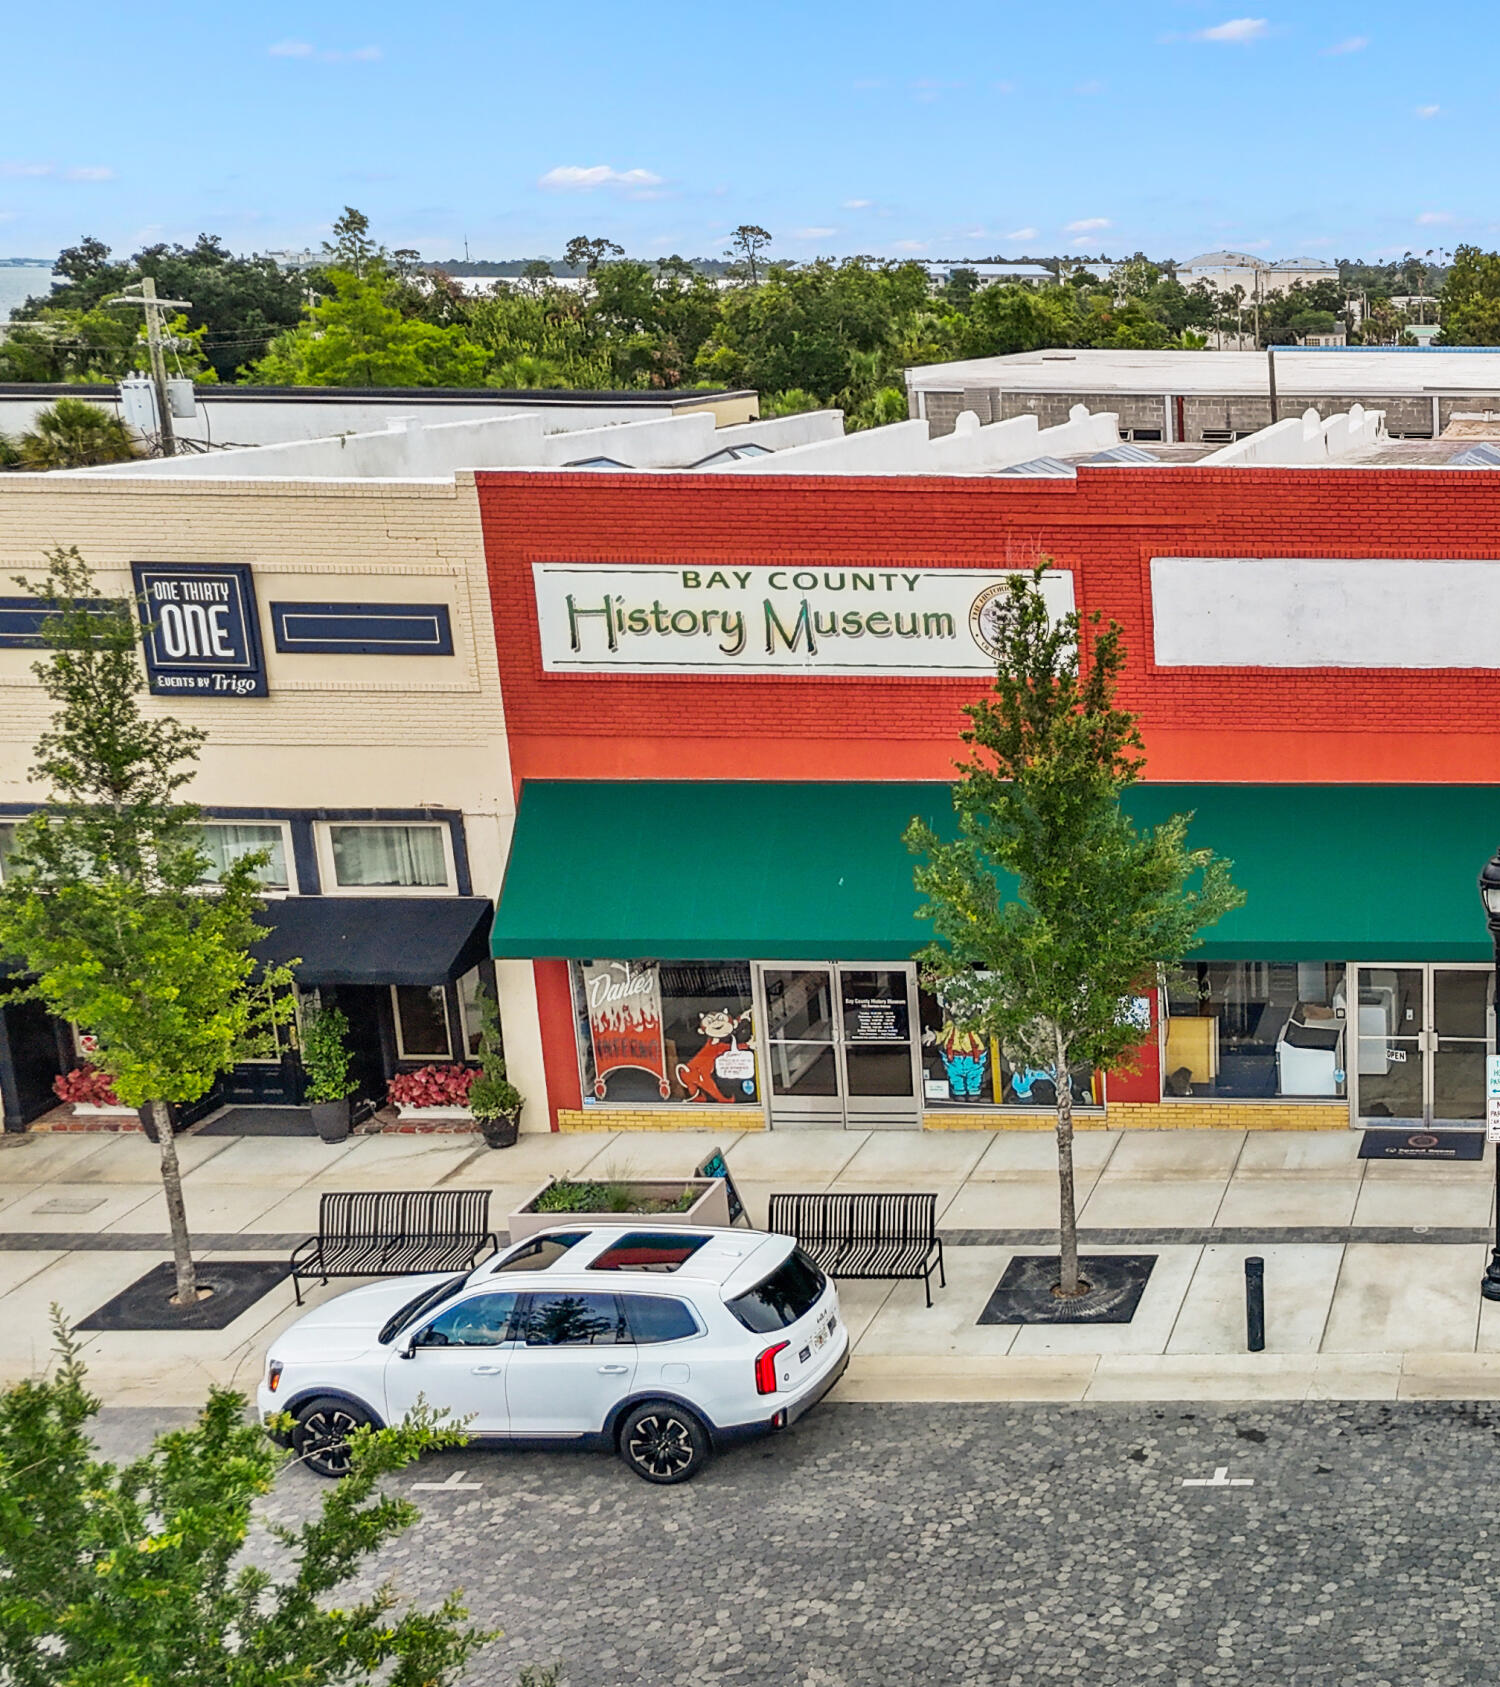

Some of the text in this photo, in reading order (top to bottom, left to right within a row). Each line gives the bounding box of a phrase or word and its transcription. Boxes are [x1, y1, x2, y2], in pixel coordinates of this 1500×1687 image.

[153, 581, 229, 601] ONE THIRTY
[682, 571, 921, 591] BAY COUNTY
[160, 604, 236, 657] ONE
[565, 594, 956, 656] History Museum
[157, 673, 256, 694] EVENTS BY Trigo
[588, 961, 654, 1009] Dante's
[1386, 1050, 1405, 1060] OPEN
